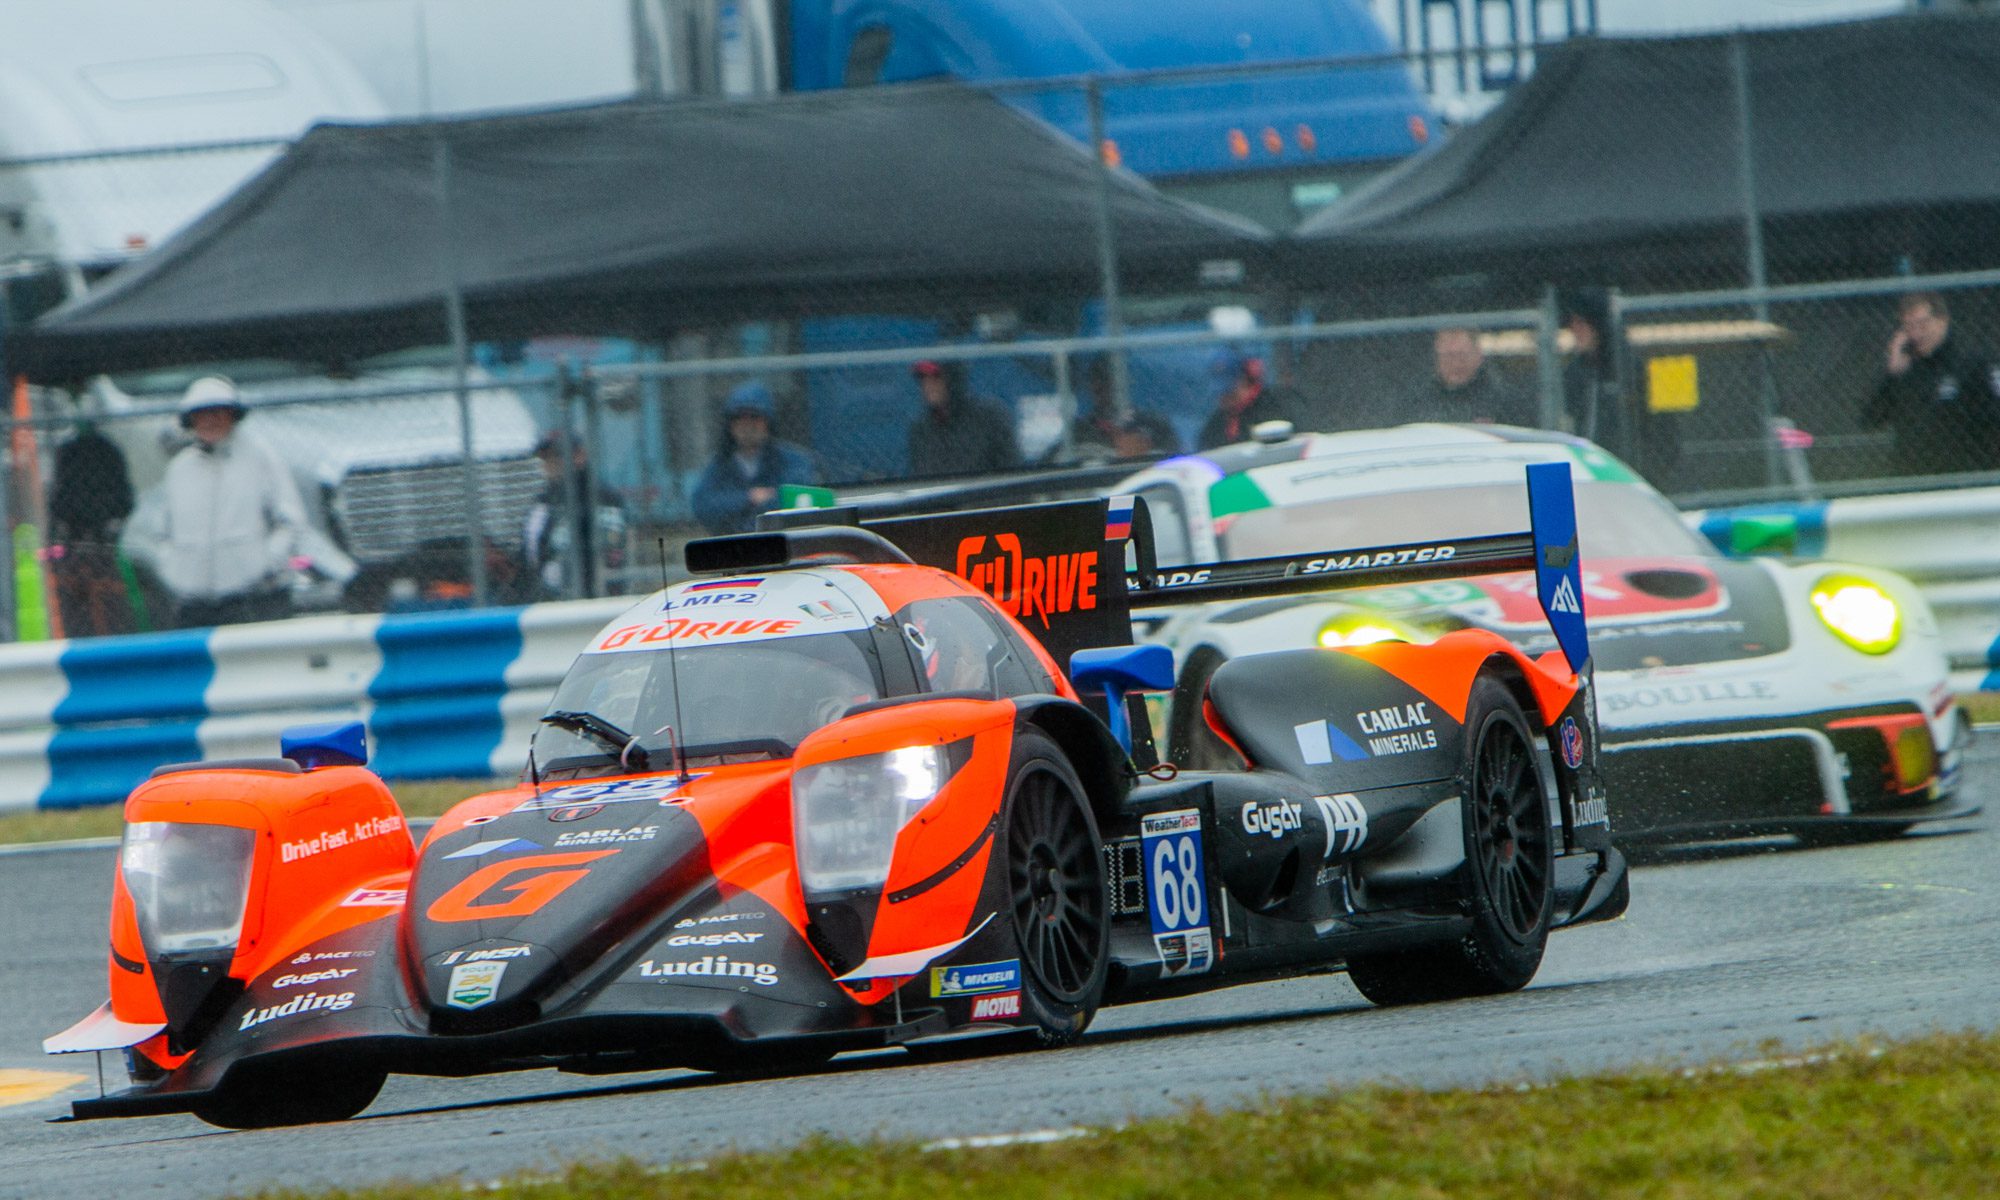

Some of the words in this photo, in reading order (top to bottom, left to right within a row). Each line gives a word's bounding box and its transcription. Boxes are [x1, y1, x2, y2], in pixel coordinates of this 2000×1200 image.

[1302, 546, 1456, 574] SMARTER
[662, 593, 758, 611] LMP2
[1606, 680, 1776, 712] BOULLE
[1356, 702, 1431, 734] CARLAC
[1368, 730, 1438, 757] MINERALS
[551, 778, 674, 798] 68
[558, 825, 660, 840] CARLAC
[1144, 816, 1198, 832] WeatherTech
[281, 838, 321, 863] Drive
[553, 834, 655, 847] MINERALS
[427, 849, 623, 922] G
[1153, 836, 1202, 929] 68
[639, 955, 779, 985] Luding
[963, 970, 1015, 986] MICHELIN
[238, 992, 356, 1031] Luding
[973, 995, 1020, 1017] MOTUL
